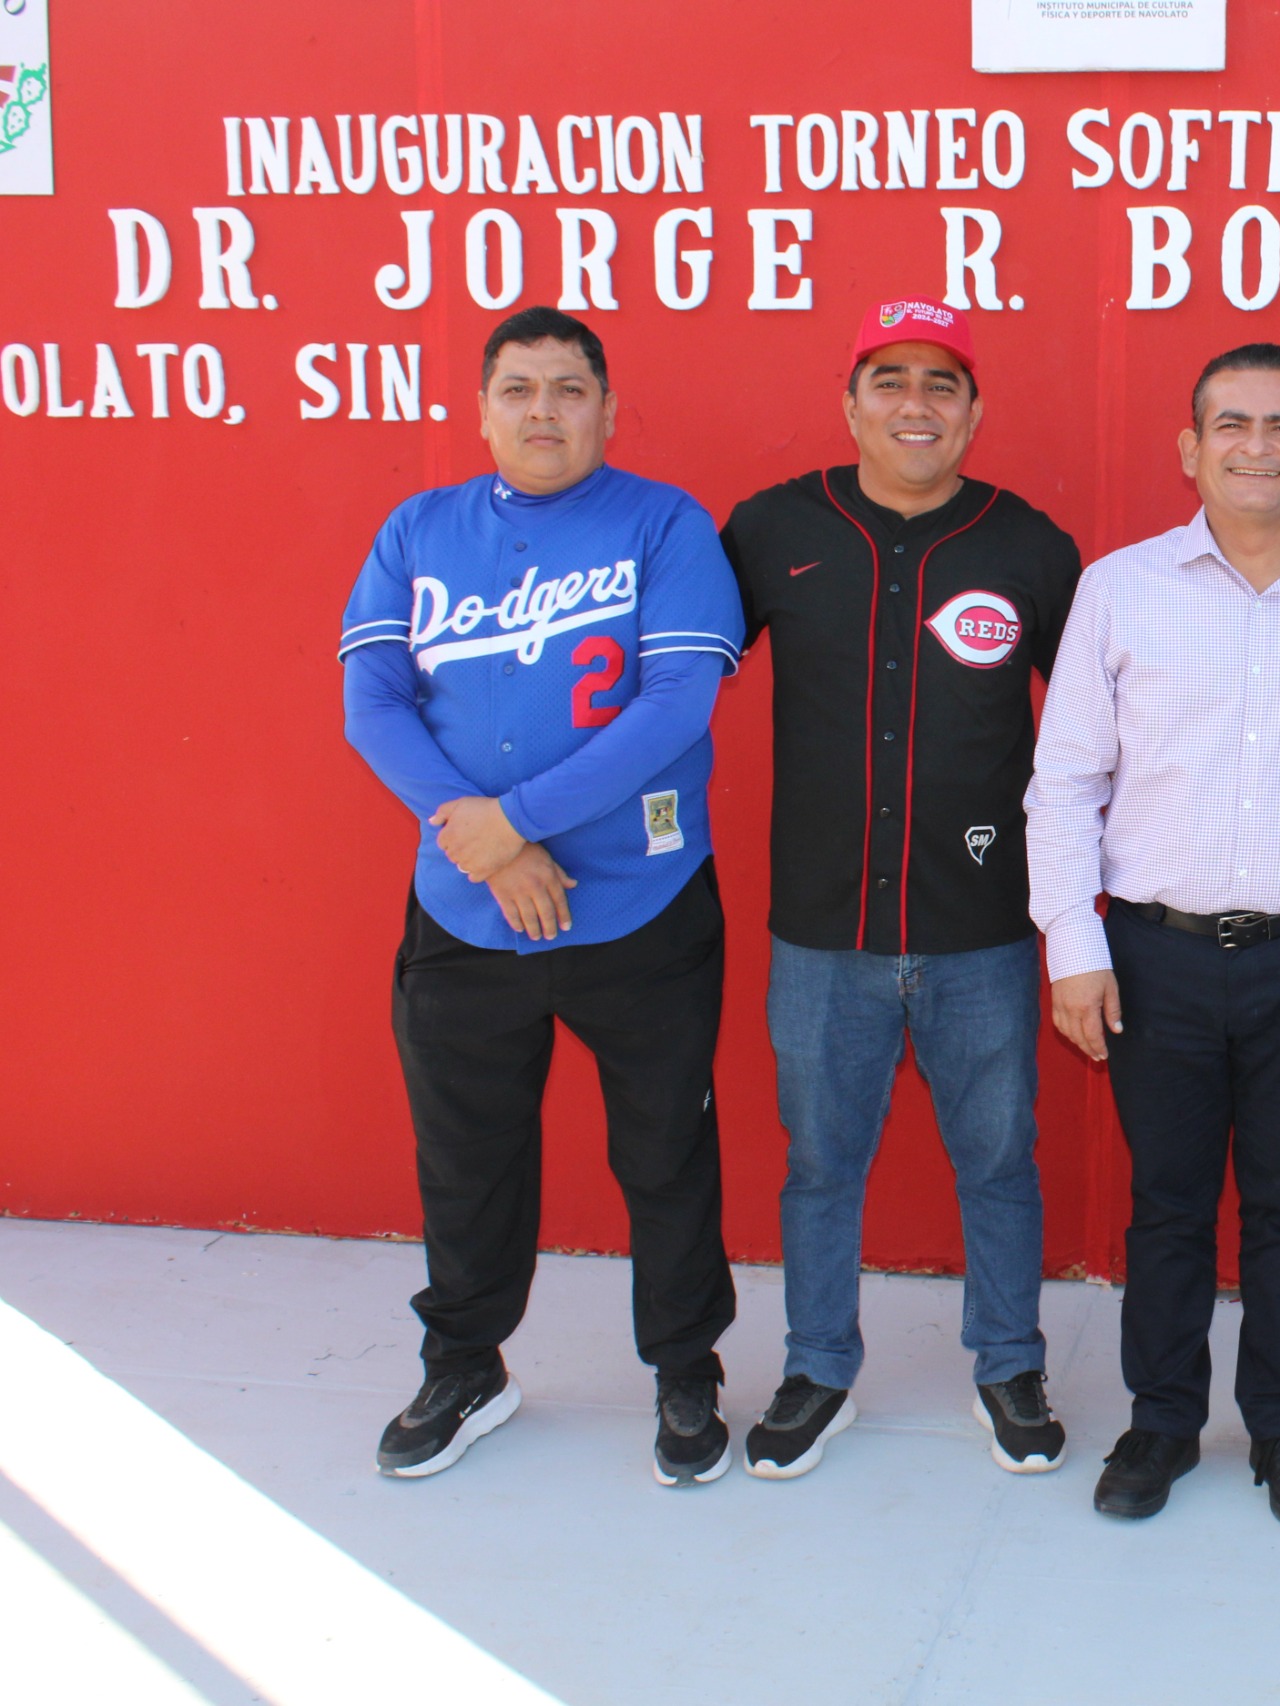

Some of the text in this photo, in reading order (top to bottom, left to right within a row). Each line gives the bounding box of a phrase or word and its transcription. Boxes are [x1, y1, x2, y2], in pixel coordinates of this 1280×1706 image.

[1037, 1, 1194, 10] INSTITUTO MUNICIPAL DE CULTURA
[1073, 10, 1079, 19] Y
[1081, 10, 1122, 19] DEPORTE
[1124, 10, 1136, 18] DE
[1138, 10, 1189, 18] NAVOLATO
[223, 111, 704, 197] INAUGURACION
[749, 108, 1026, 193] TORNEO
[107, 206, 278, 311] DR.
[374, 206, 813, 311] JORGE
[940, 207, 1024, 311] R.
[908, 302, 953, 319] NAVOLATO
[295, 342, 447, 422] SIN.
[410, 559, 636, 665] Dodgers
[959, 618, 1018, 642] REDS
[571, 636, 625, 728] 2
